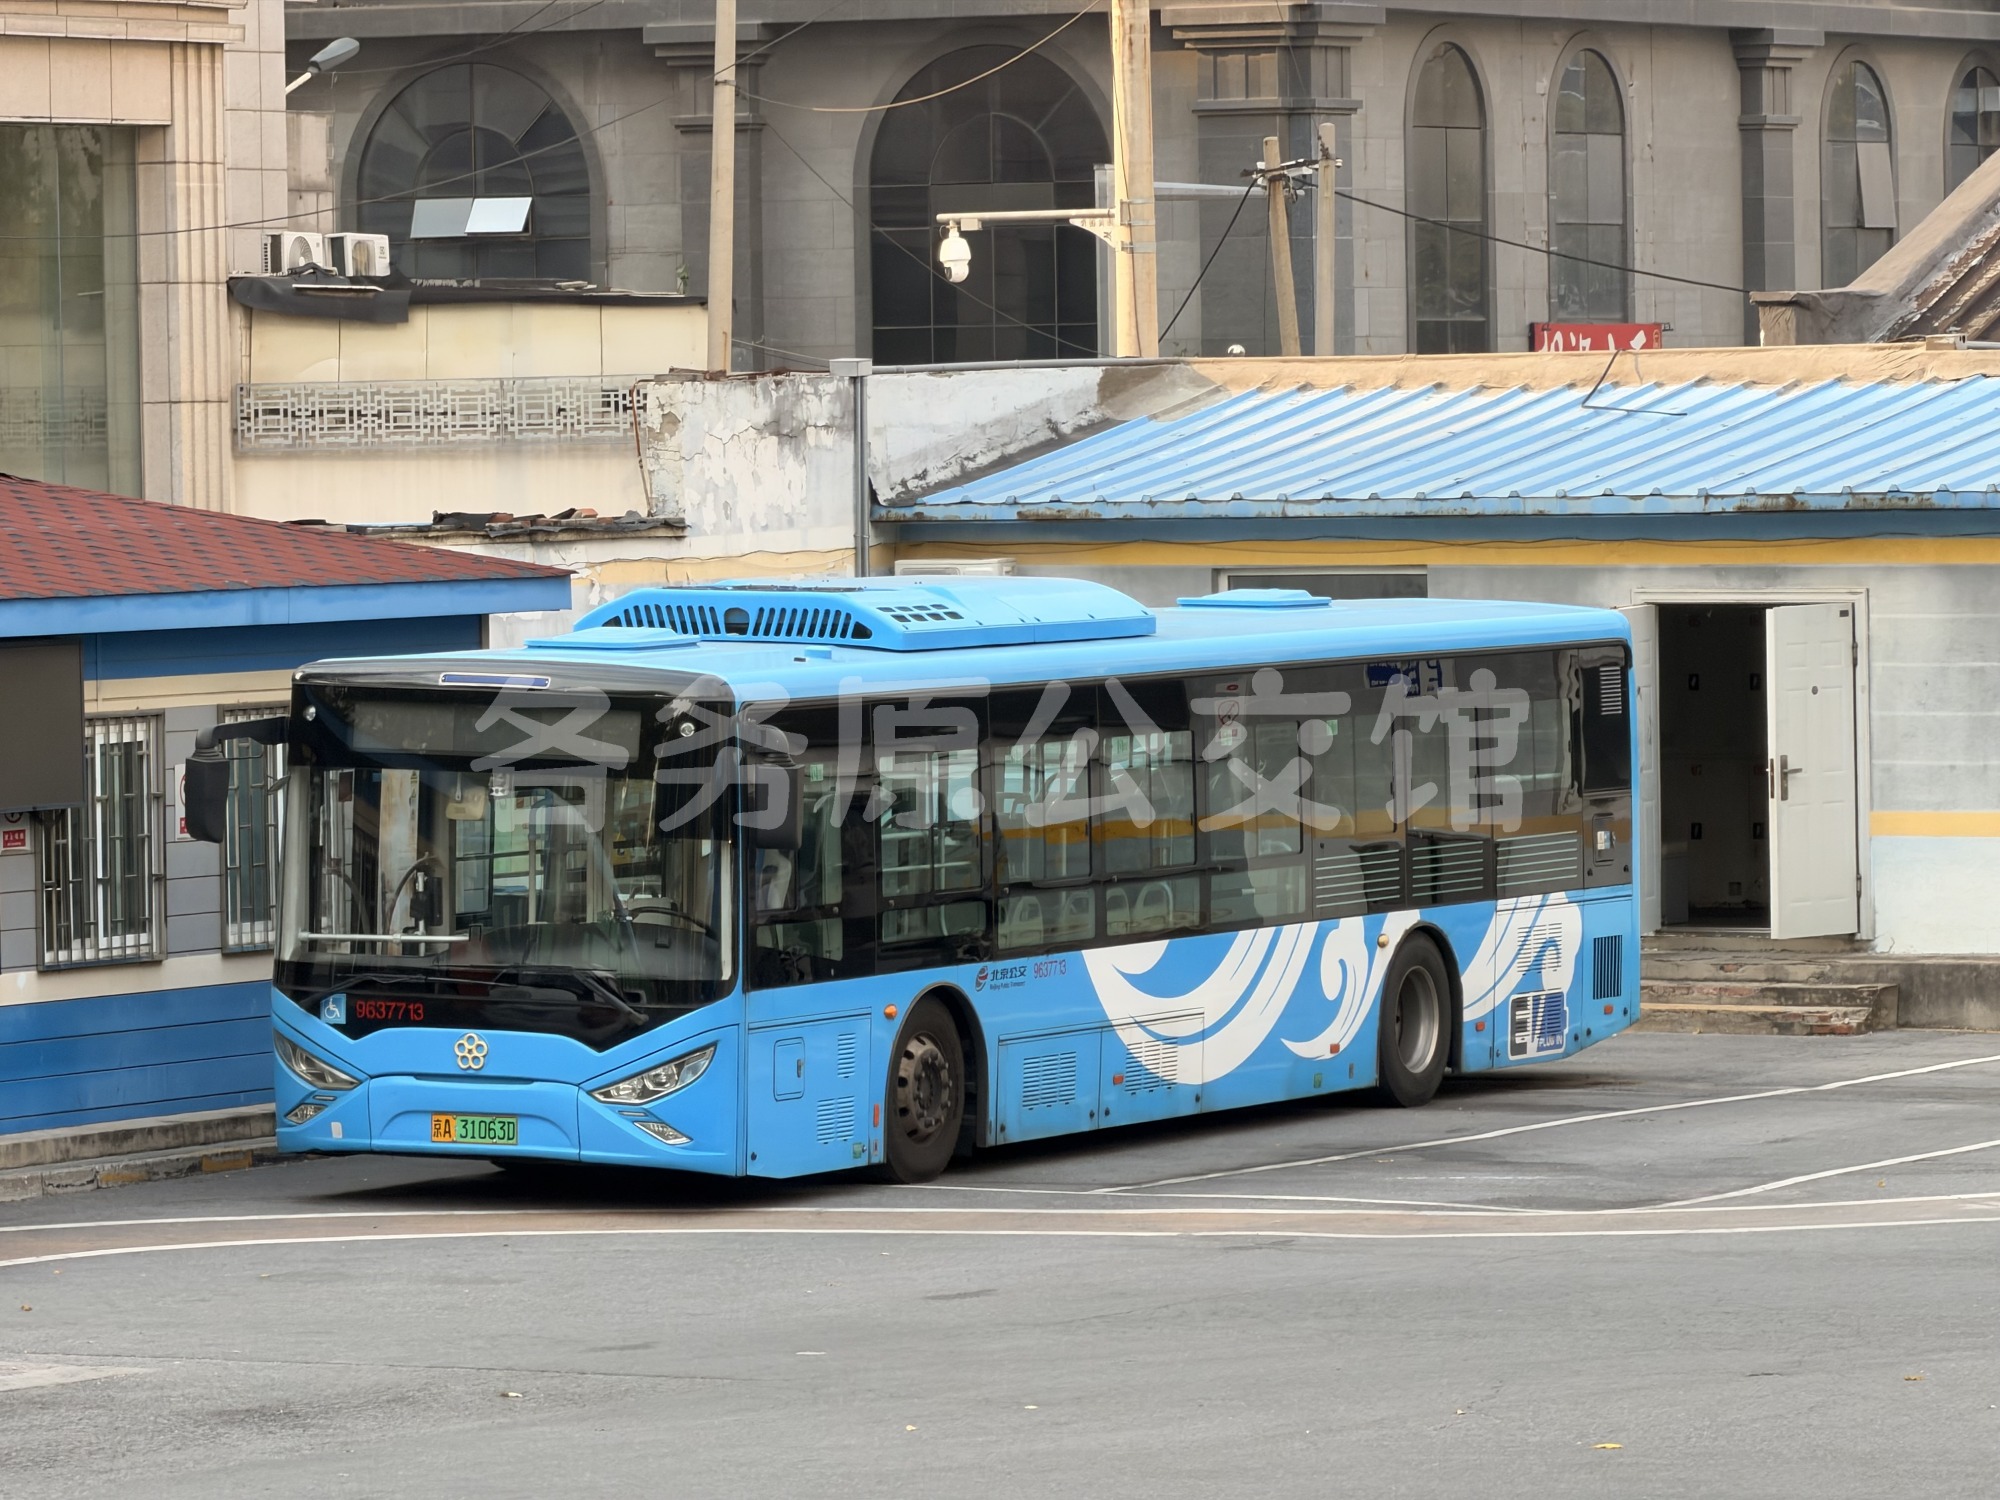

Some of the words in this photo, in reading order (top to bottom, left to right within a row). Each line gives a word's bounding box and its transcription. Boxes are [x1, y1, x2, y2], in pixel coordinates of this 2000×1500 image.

[990, 965, 1027, 981] 北京公交
[1033, 959, 1067, 979] 9637713
[355, 1000, 424, 1021] 9637713
